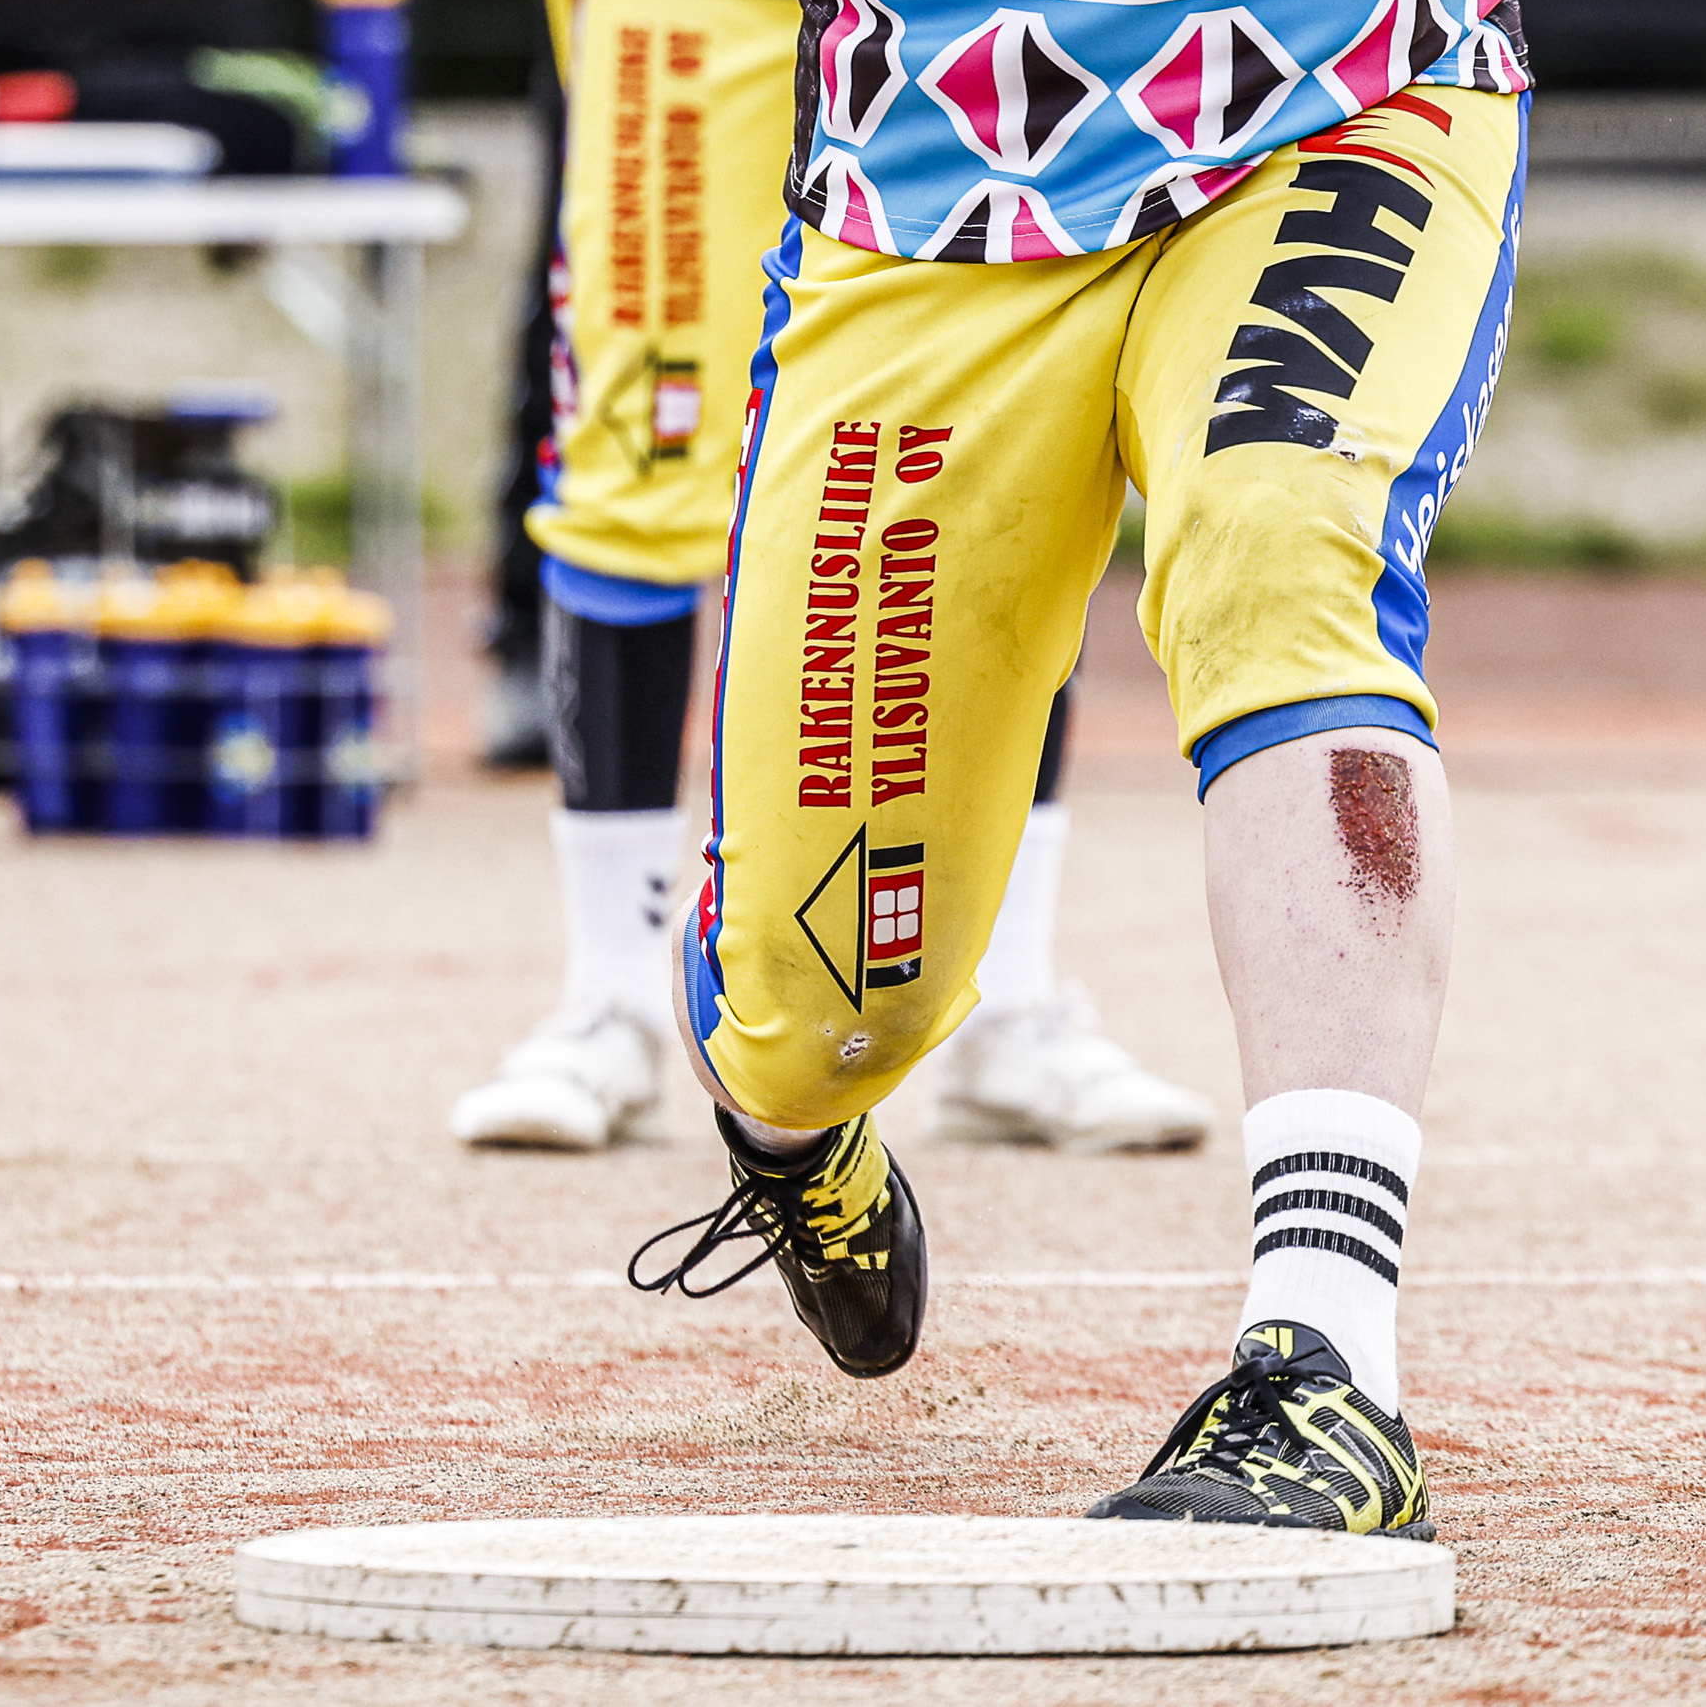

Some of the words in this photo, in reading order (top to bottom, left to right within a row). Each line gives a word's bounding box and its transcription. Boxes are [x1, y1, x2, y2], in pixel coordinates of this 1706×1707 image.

[895, 424, 954, 485] OY
[798, 419, 882, 809] RAKENNUSLIIKE
[871, 518, 940, 809] YLISUVANTO
